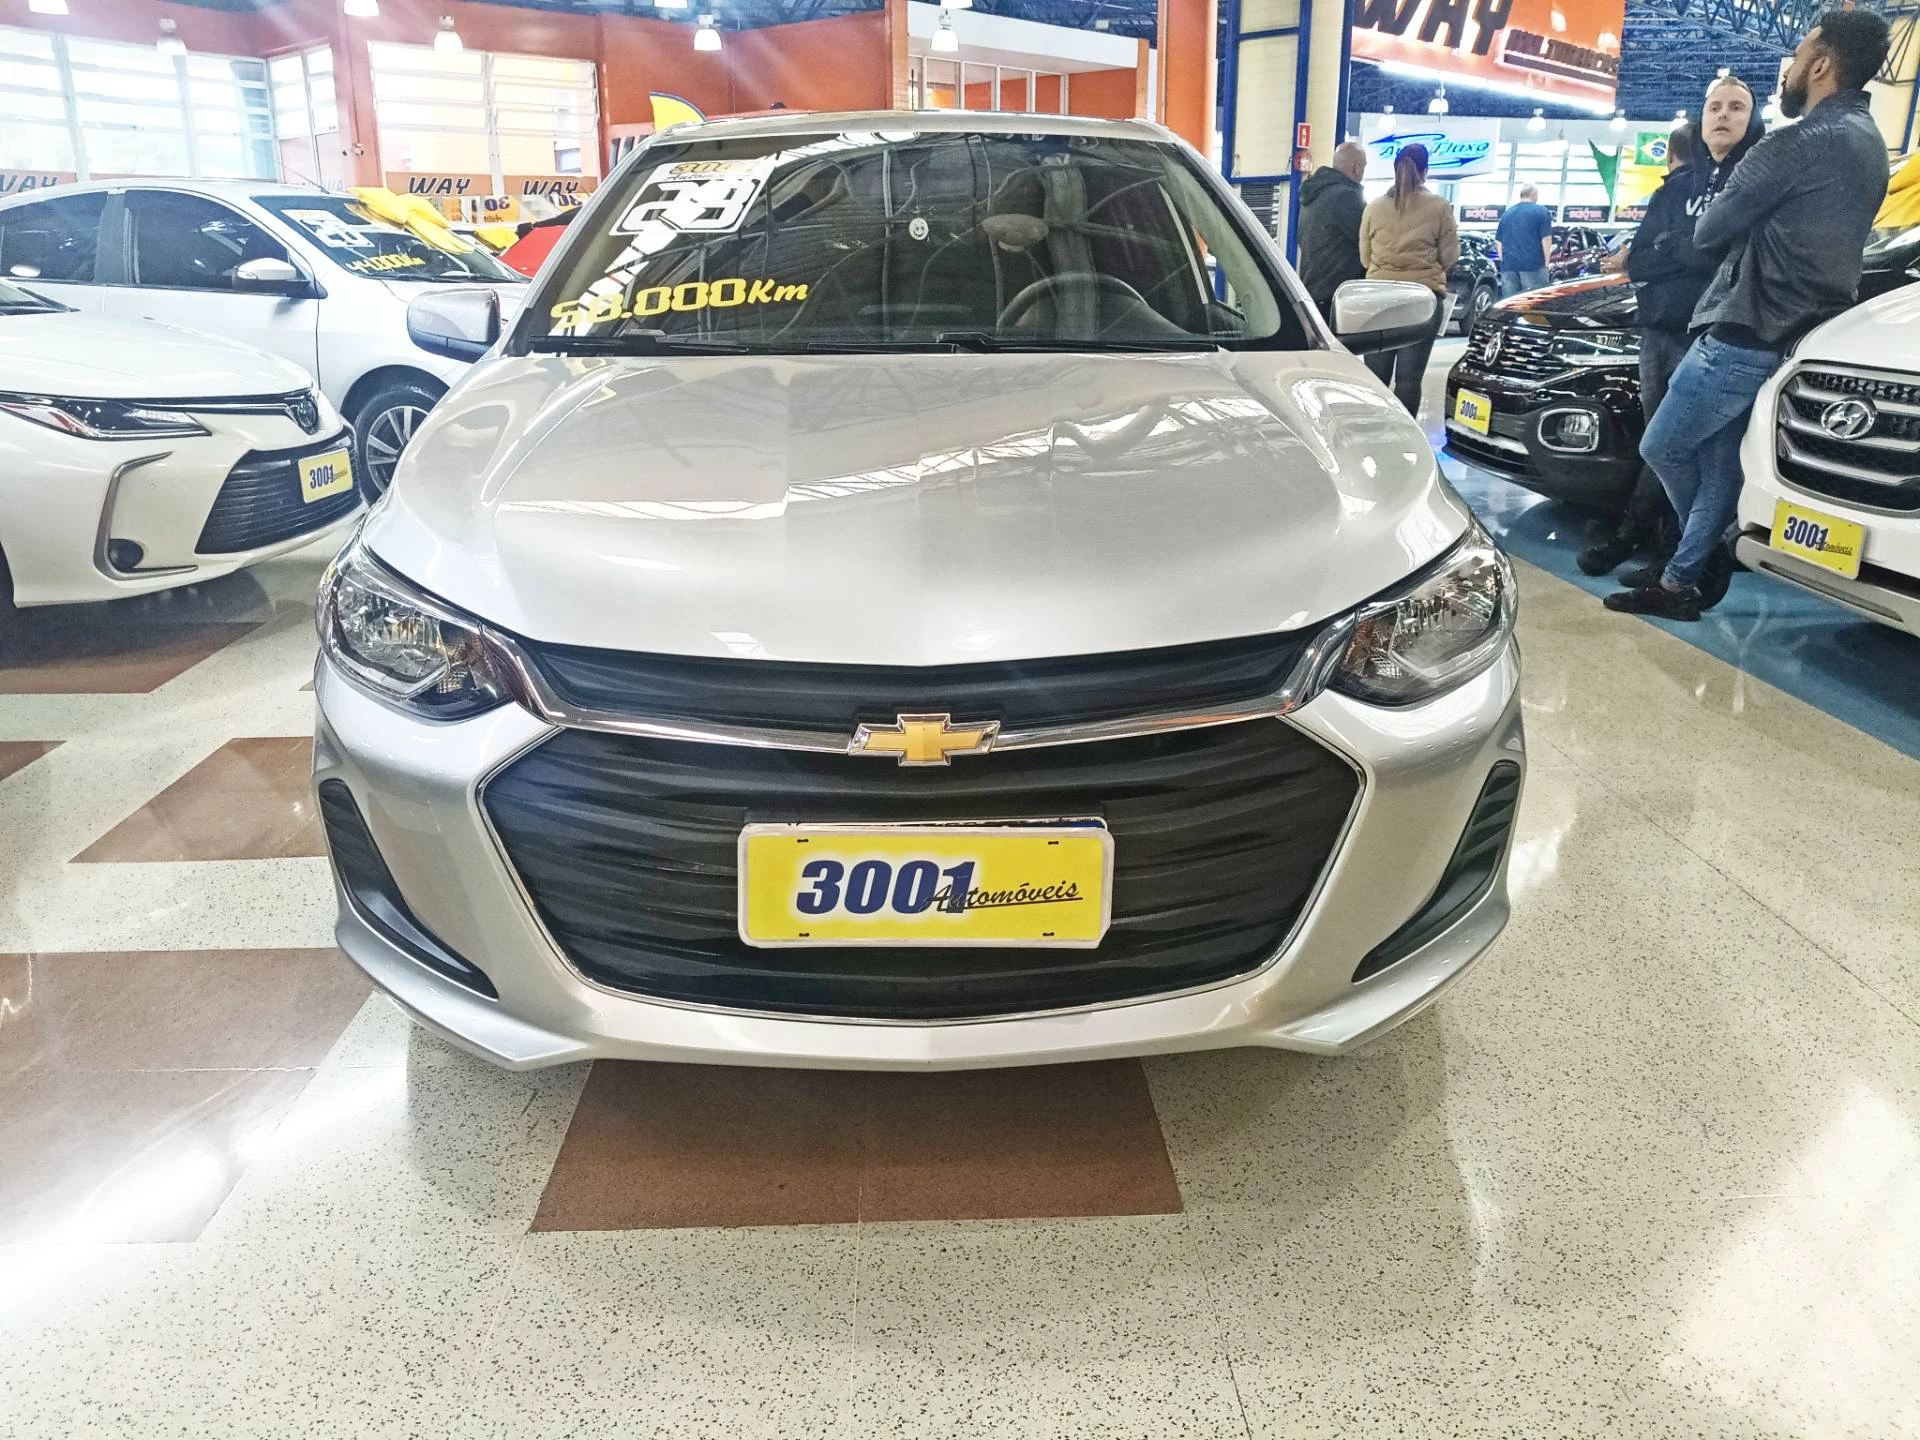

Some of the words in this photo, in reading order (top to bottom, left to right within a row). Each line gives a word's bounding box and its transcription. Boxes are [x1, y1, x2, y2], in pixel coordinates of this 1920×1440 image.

[1352, 0, 1513, 56] WAY
[408, 177, 471, 195] WAY
[523, 180, 579, 196] WAY
[1460, 400, 1478, 420] 3001
[309, 463, 335, 489] 3001
[1784, 516, 1829, 551] 3001
[796, 860, 975, 914] 3001
[925, 879, 1083, 912] Automóveis
